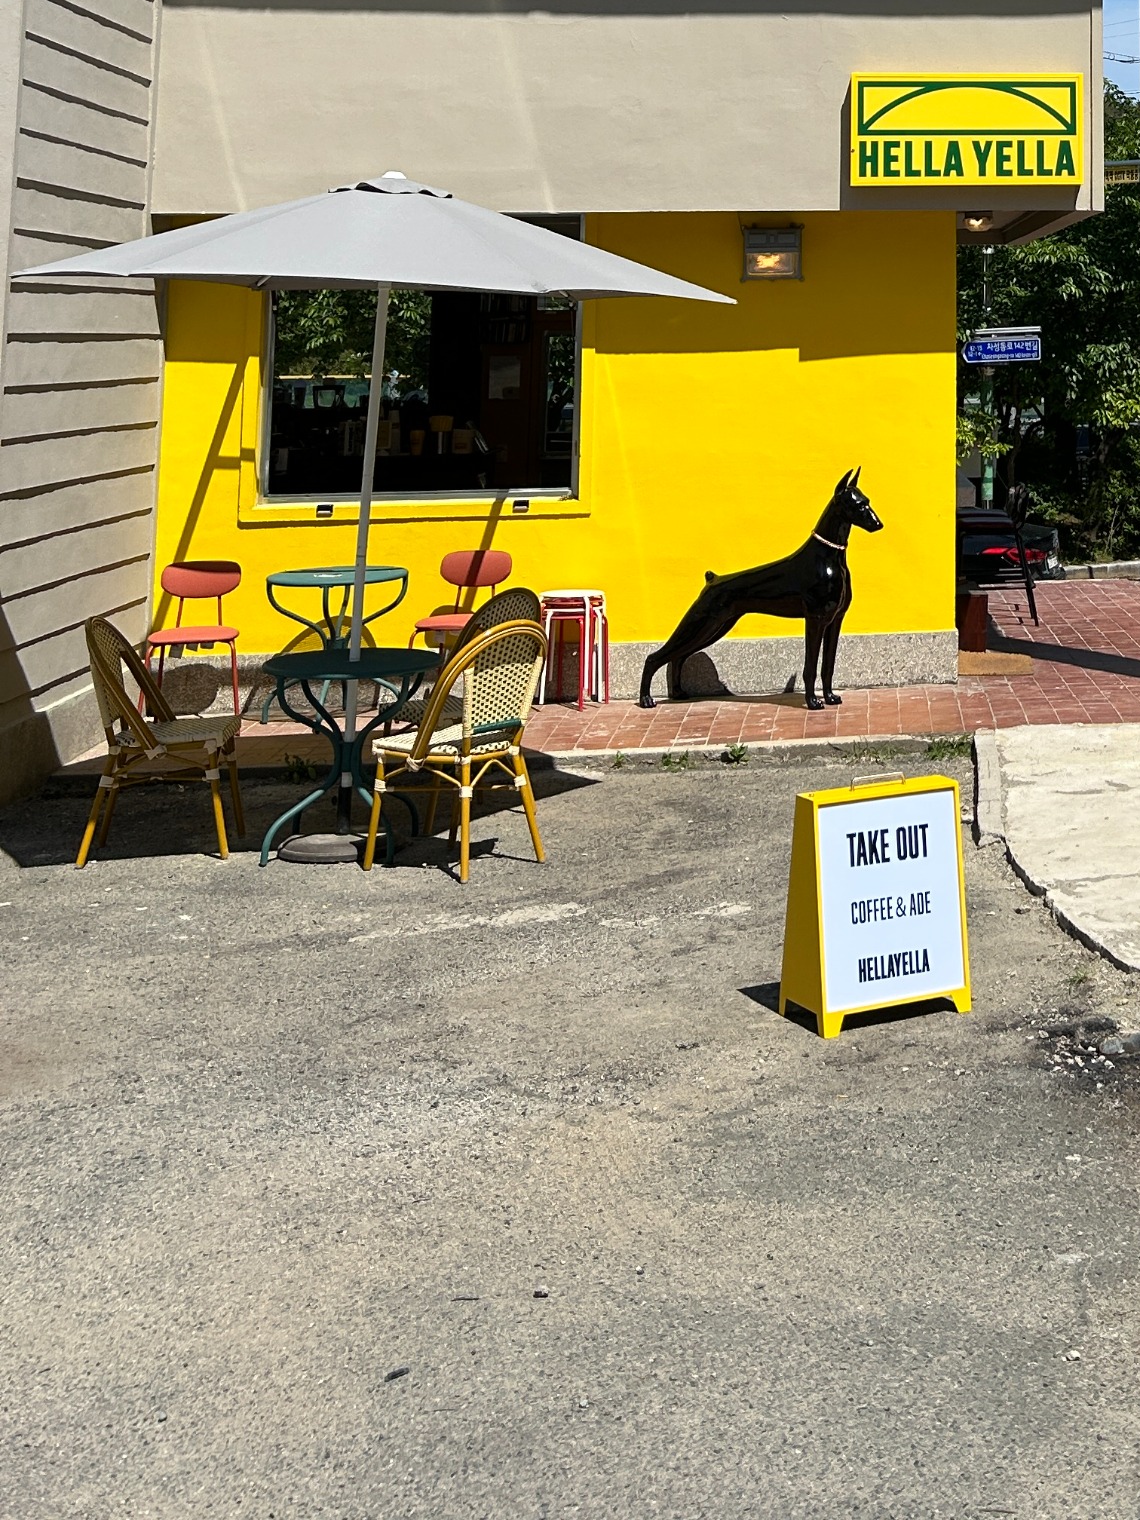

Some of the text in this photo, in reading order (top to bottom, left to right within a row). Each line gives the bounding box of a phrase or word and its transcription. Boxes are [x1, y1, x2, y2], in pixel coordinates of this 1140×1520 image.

[845, 823, 930, 868] TAKE OUT
[850, 890, 932, 925] COFFEE & ADE
[857, 948, 931, 983] HELLAYELLA
